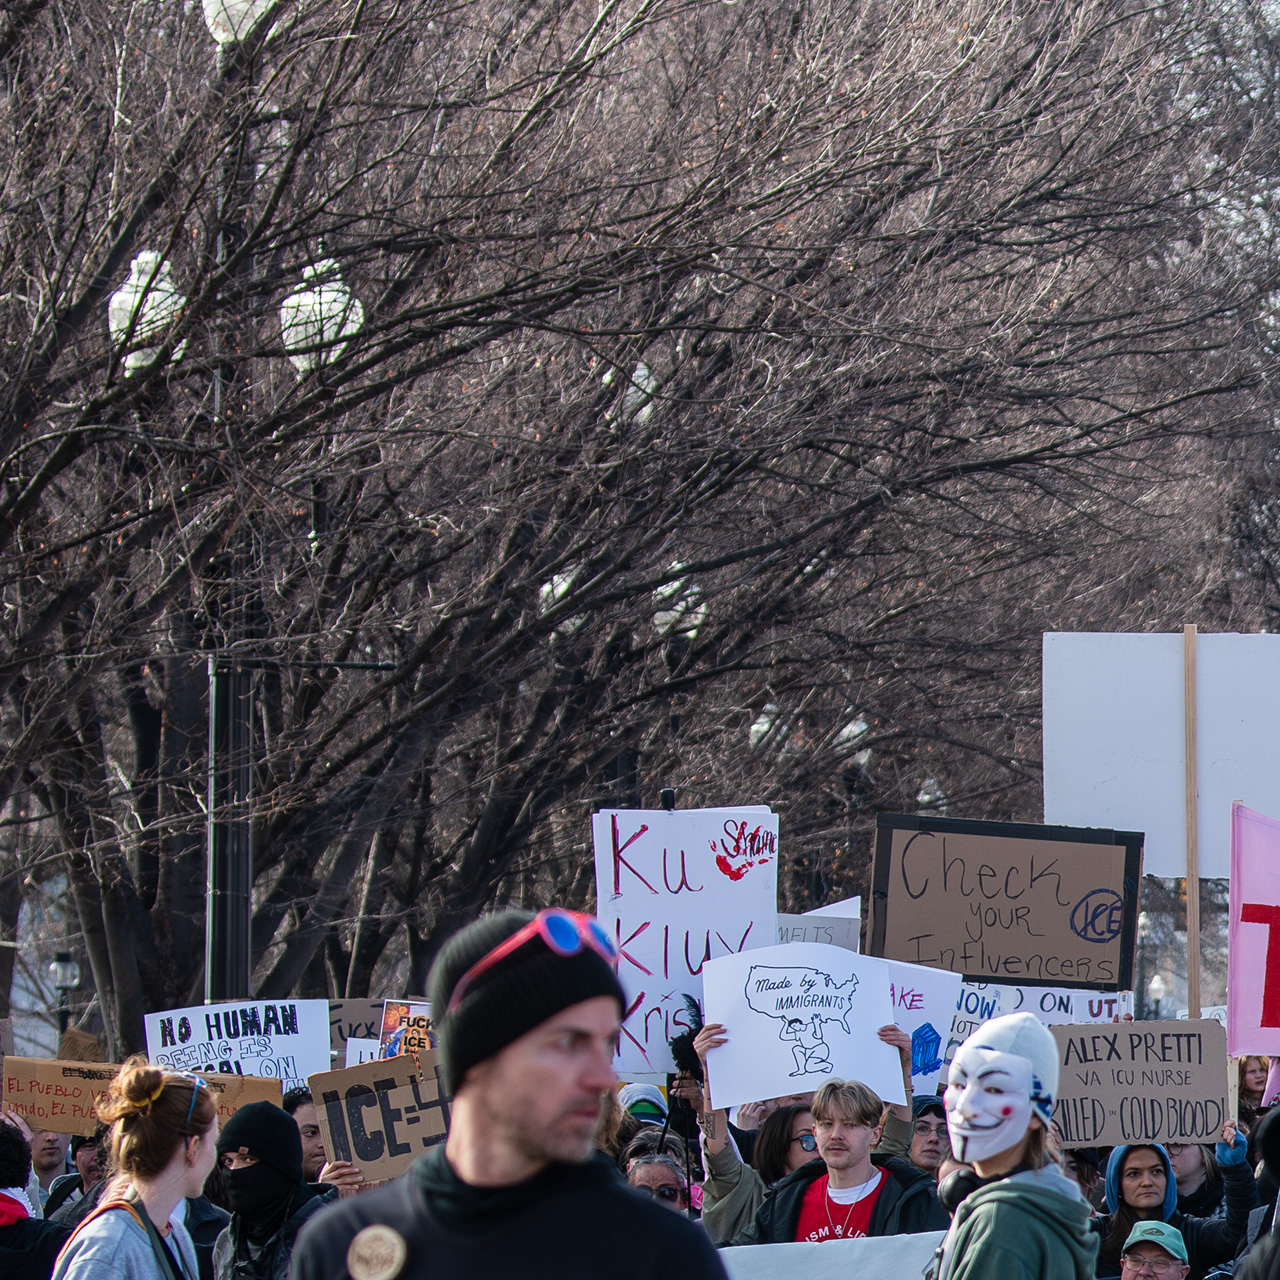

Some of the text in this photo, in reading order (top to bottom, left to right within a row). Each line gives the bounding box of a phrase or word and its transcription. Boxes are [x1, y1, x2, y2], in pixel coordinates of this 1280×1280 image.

[901, 831, 1070, 906] Check
[799, 973, 818, 994] by
[775, 994, 846, 1011] IMMIGRANTS
[159, 1015, 192, 1048] NO
[205, 1002, 300, 1042] HUMAN
[403, 1035, 428, 1049] ICE
[1063, 1031, 1203, 1067] ALEX PRETTI
[7, 1076, 82, 1099] EL PUEBLO
[1075, 1068, 1193, 1086] VA ICU NURSE
[1119, 1096, 1163, 1141] COLD
